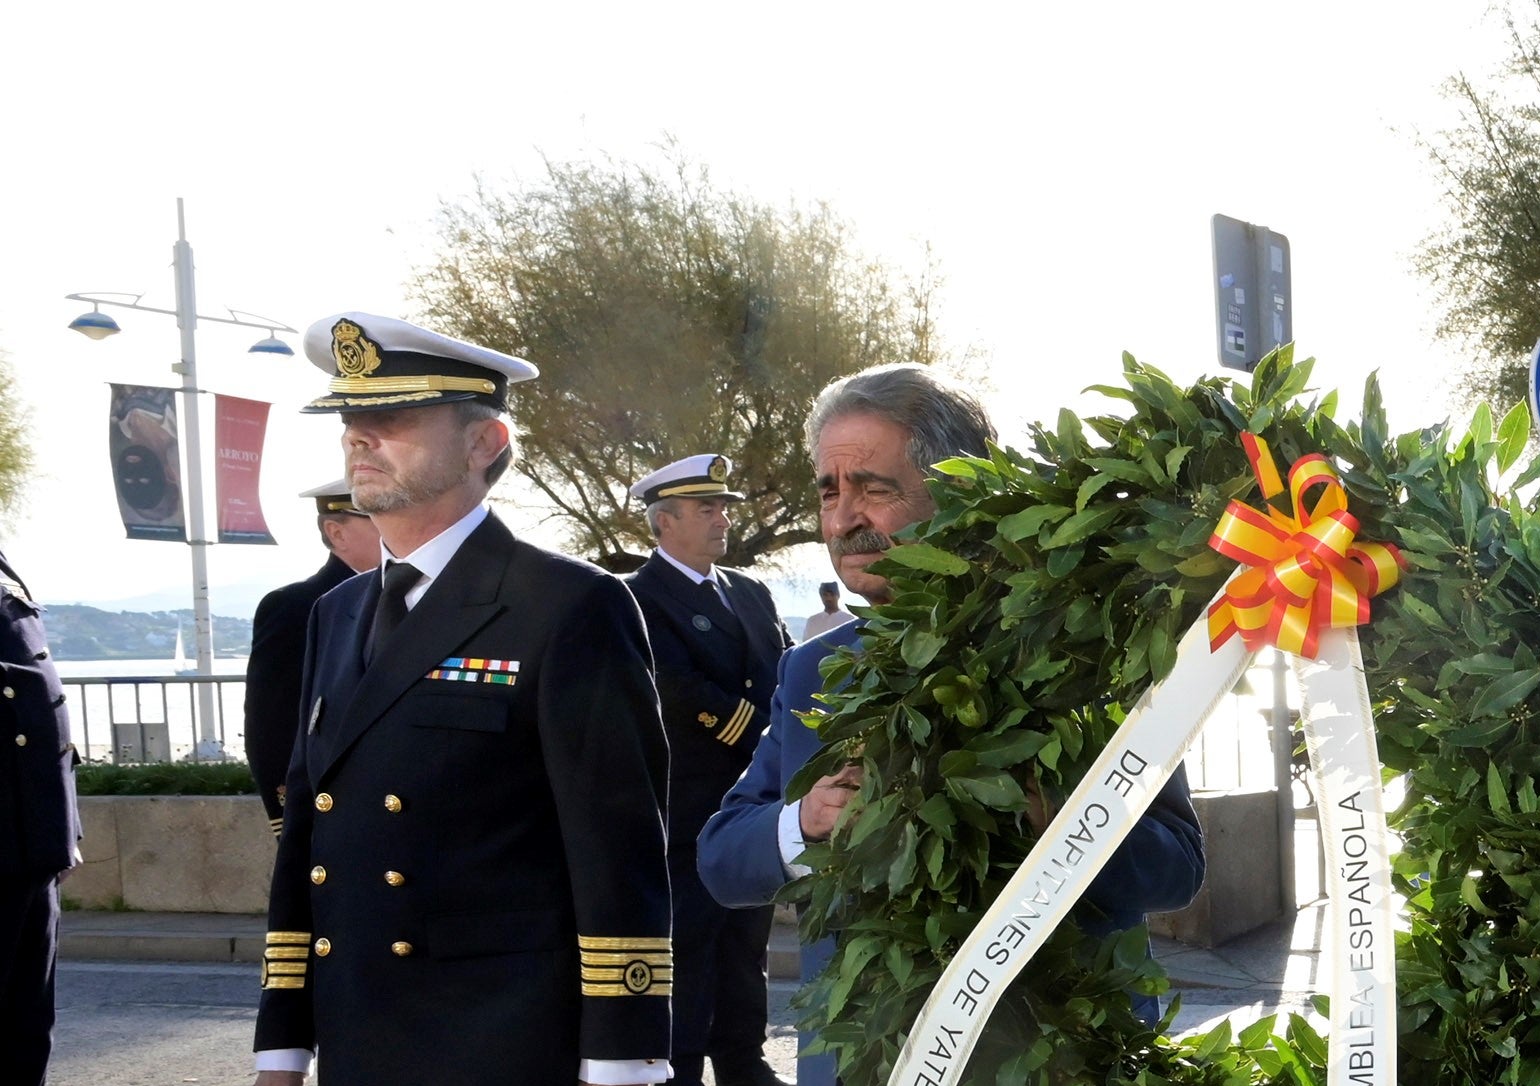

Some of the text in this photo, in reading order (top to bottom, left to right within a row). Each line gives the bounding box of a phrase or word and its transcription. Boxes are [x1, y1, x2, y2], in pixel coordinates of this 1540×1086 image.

[1104, 749, 1148, 798] DE
[985, 803, 1110, 966] CAPITANES
[1338, 790, 1374, 972] ESPAÑOLA
[952, 968, 991, 1016] DE
